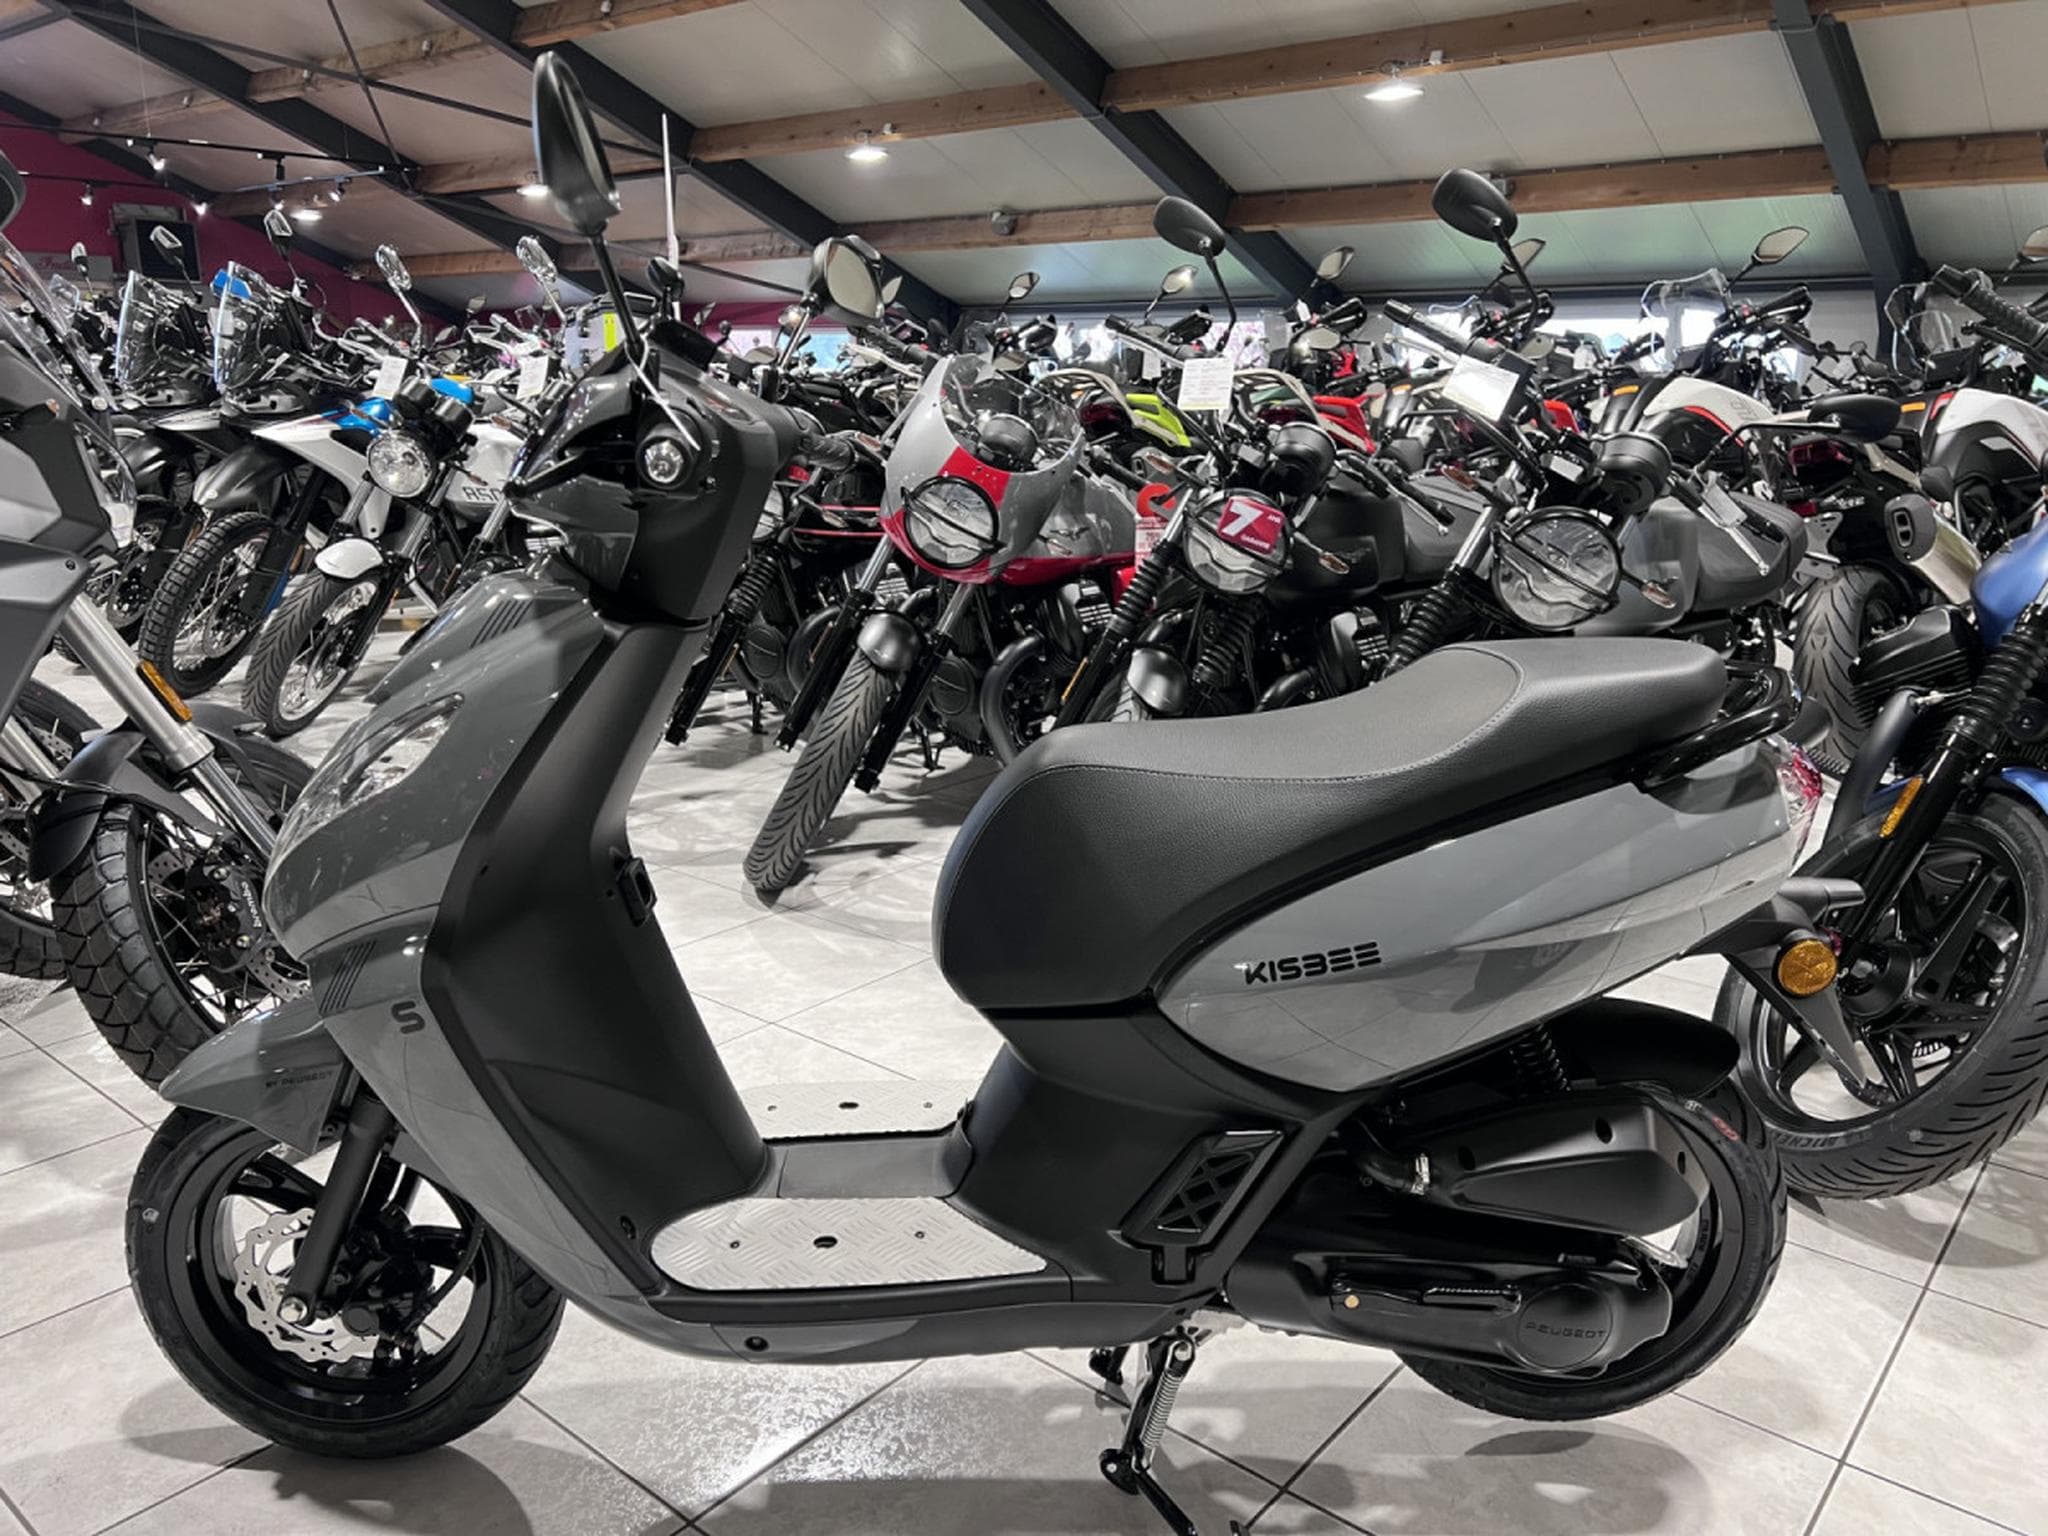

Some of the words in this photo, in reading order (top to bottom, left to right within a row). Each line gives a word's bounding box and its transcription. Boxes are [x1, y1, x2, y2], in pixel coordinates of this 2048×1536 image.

[1221, 500, 1264, 536] 7
[241, 881, 262, 928] brembo
[1245, 941, 1382, 985] KISBEE
[391, 1001, 426, 1034] S
[1525, 1321, 1607, 1339] PEUGEOT
